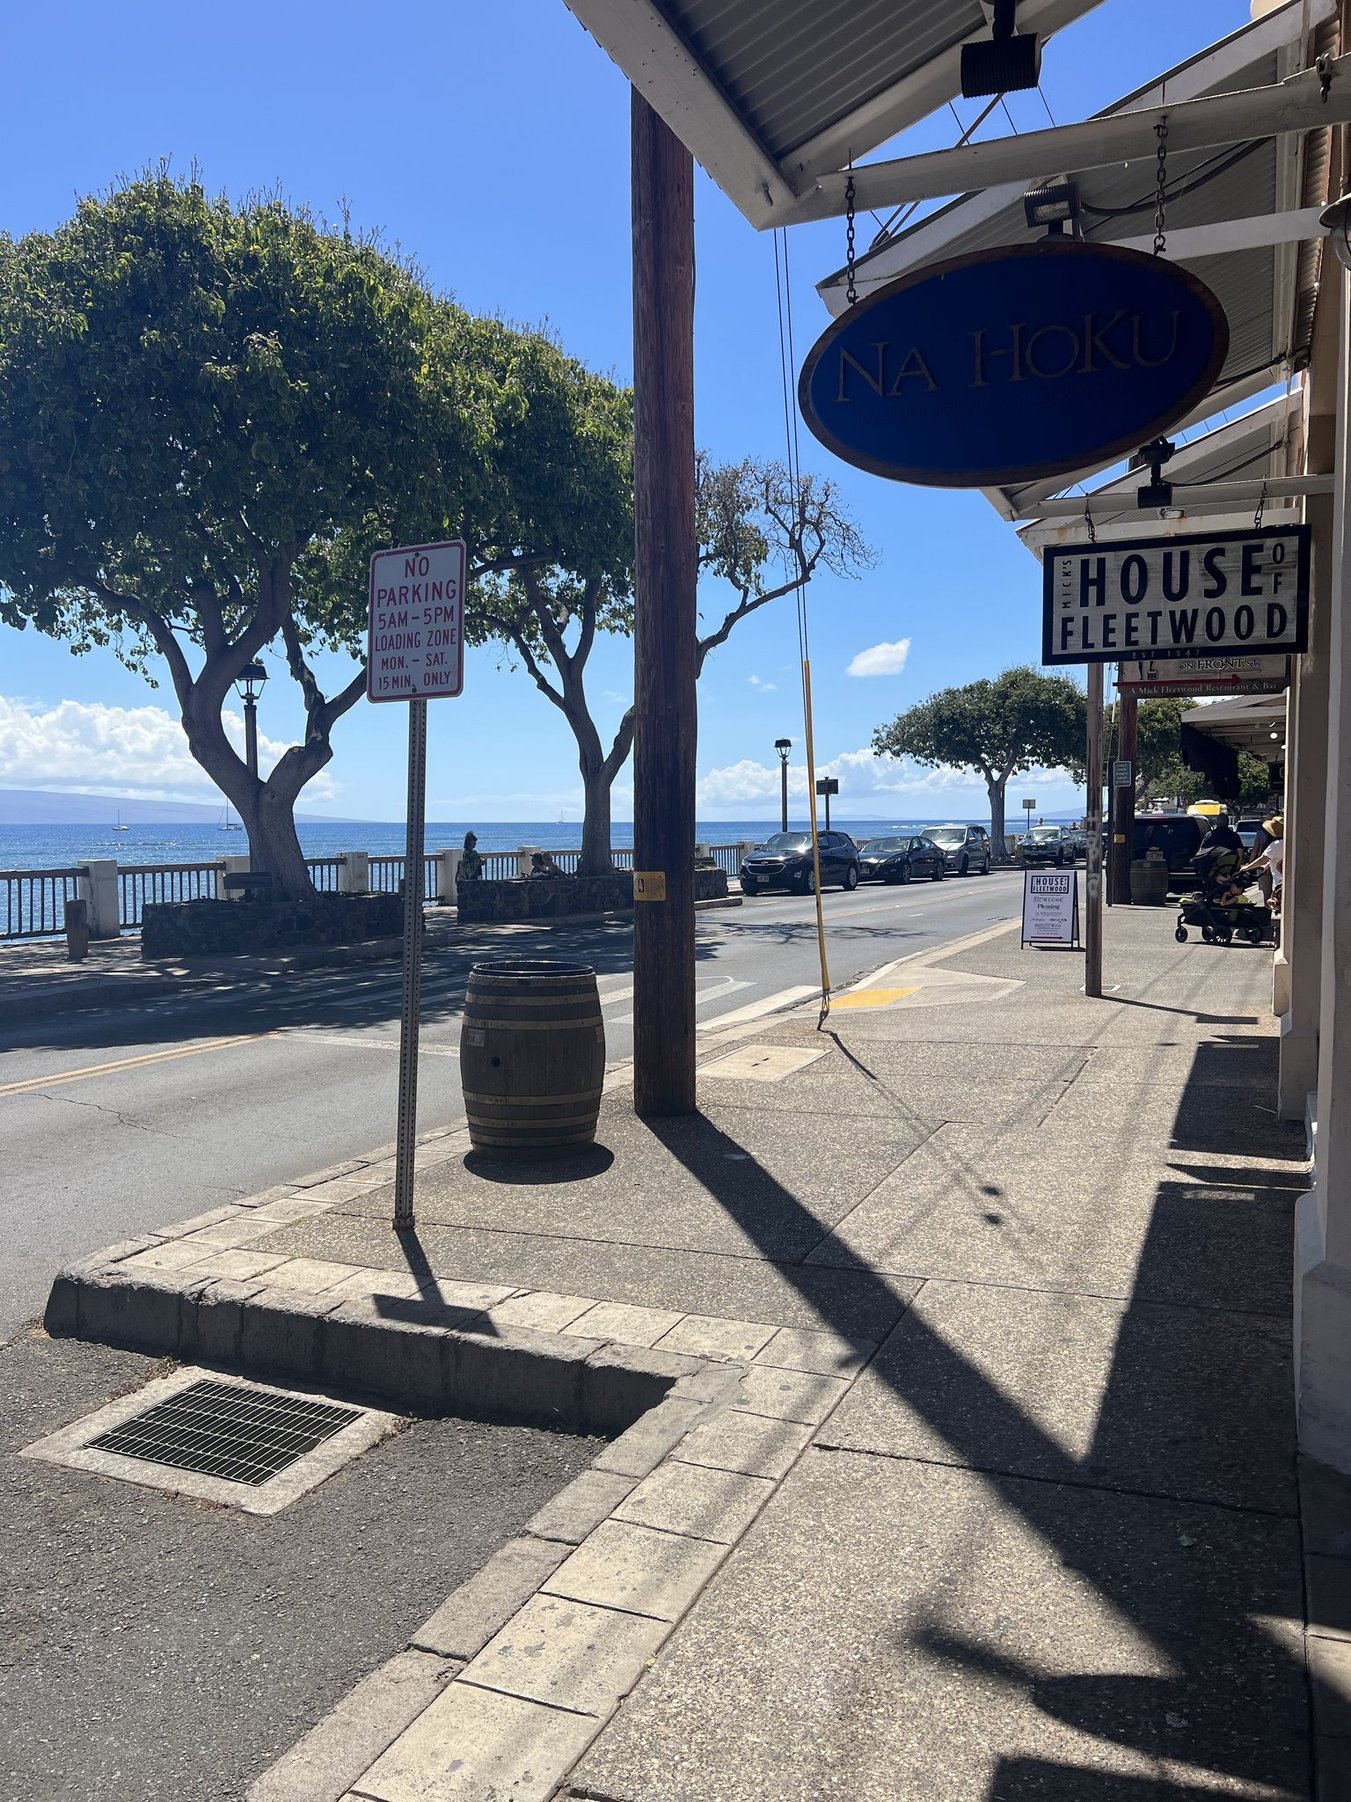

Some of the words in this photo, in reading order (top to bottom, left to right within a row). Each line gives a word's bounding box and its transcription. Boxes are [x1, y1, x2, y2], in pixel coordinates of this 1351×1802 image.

[834, 340, 941, 402] NA
[968, 309, 1182, 388] HOKU
[404, 556, 430, 578] NO
[1080, 544, 1264, 608] HOUSE
[1272, 543, 1285, 594] OF
[377, 579, 456, 608] PARKING
[1062, 560, 1072, 609] MICK'S
[1061, 602, 1287, 650] FLEETWOOD
[375, 632, 421, 652] LOADING
[427, 628, 457, 647] ZONE
[1167, 649, 1200, 657] 1947
[1179, 662, 1193, 671] ON
[1196, 658, 1245, 670] FRONT
[424, 670, 451, 686] ONLY
[1138, 687, 1158, 695] Mick
[1161, 685, 1203, 694] Fleetwood
[1205, 684, 1249, 692] Restaurant
[1263, 682, 1277, 690] Bar
[1036, 878, 1064, 886] HOUSE
